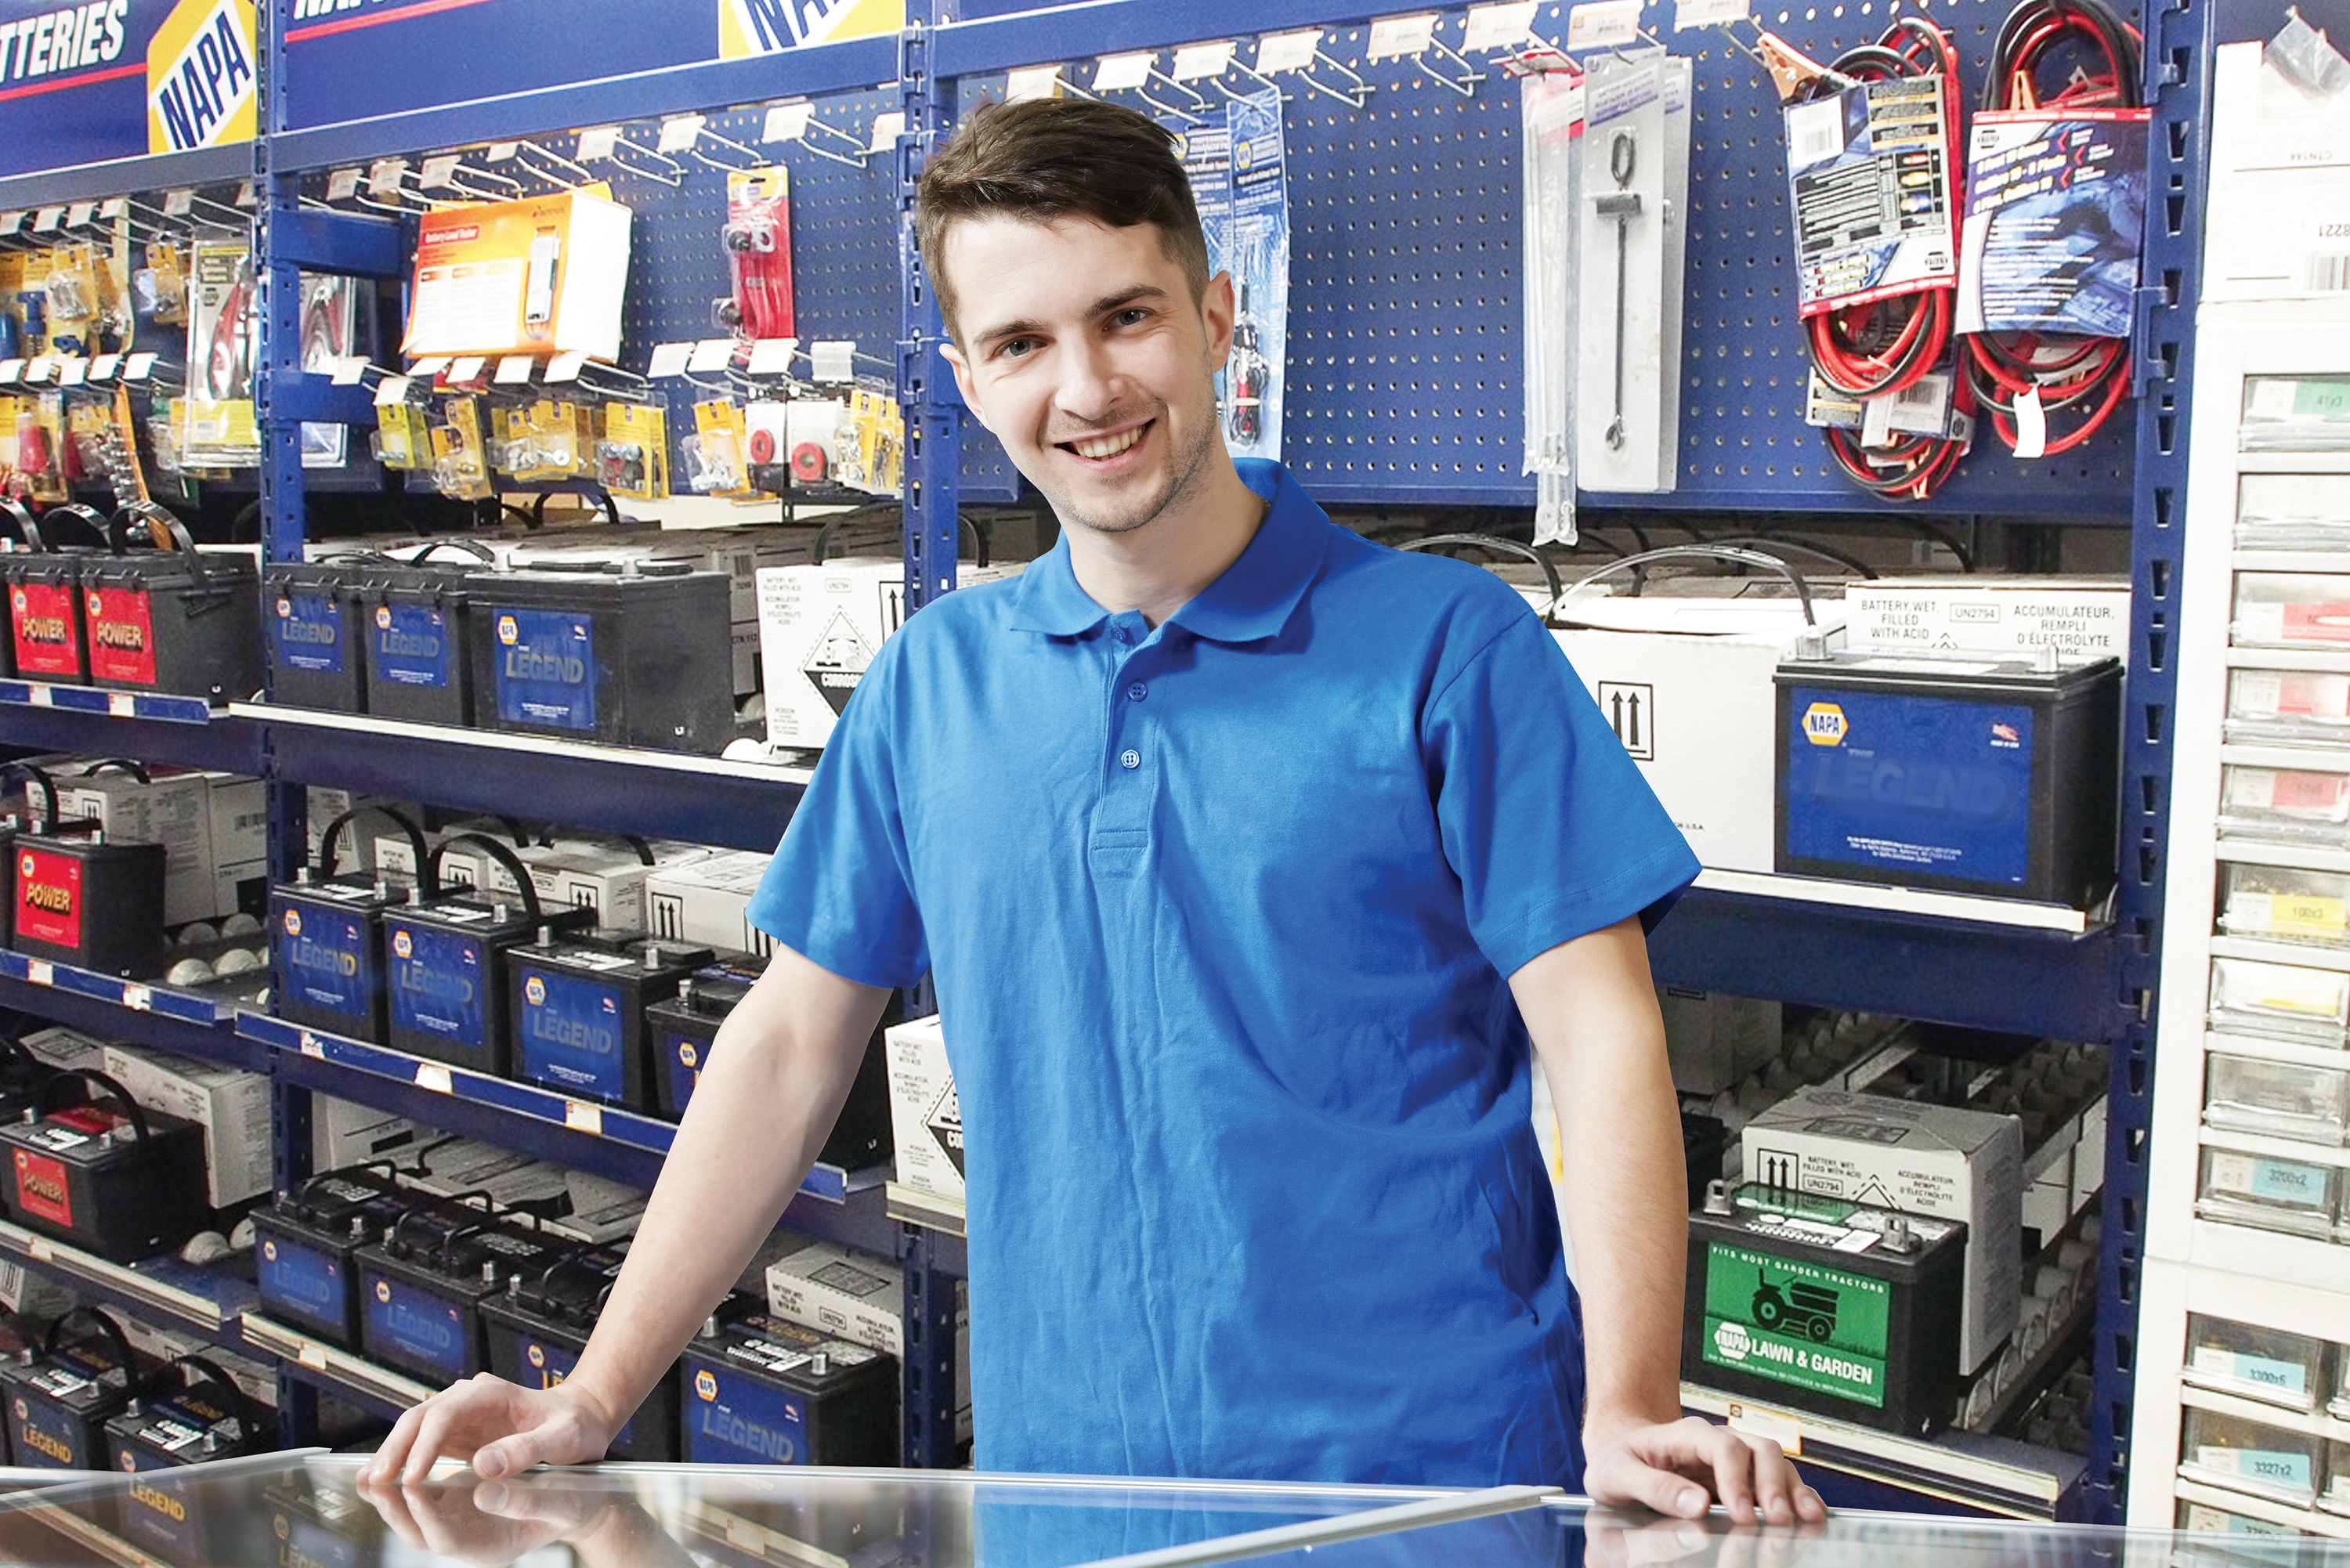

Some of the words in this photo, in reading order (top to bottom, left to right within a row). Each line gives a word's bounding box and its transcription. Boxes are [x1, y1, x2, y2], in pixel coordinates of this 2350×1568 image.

[159, 10, 251, 150] NAPA
[22, 617, 66, 642] POWER
[1882, 614, 1919, 626] FILLED
[1955, 608, 1995, 619] UN2794
[2041, 620, 2087, 631] REMPLI
[96, 621, 143, 649] POWER
[282, 620, 335, 645] LEGEND
[381, 631, 440, 658] LEGEND
[1871, 628, 1900, 639] WITH
[1903, 629, 1929, 639] ACID
[505, 651, 584, 685] LEGEND
[1810, 715, 1839, 735] NAPA
[1813, 753, 2007, 815] LEGEND
[26, 883, 71, 914] POWER
[292, 941, 356, 977] LEGEND
[401, 963, 473, 1003] LEGEND
[533, 1012, 613, 1054] LEGEND
[1806, 1180, 1839, 1191] UN2794
[274, 1263, 330, 1303] LEGEND
[1712, 1246, 1736, 1259] FITS
[1741, 1250, 1770, 1266] MOST
[1775, 1259, 1820, 1278] GARDEN
[1824, 1273, 1885, 1293] TRACTORS
[387, 1306, 451, 1349] LEGEND
[1719, 1331, 1748, 1352] NAPA
[1752, 1338, 1794, 1365] LAWN
[1796, 1349, 1808, 1368] &
[1811, 1353, 1873, 1385] GARDEN
[23, 1423, 72, 1464] LEGEND
[703, 1407, 794, 1463] LEGEND
[129, 1479, 186, 1522] LEGEND
